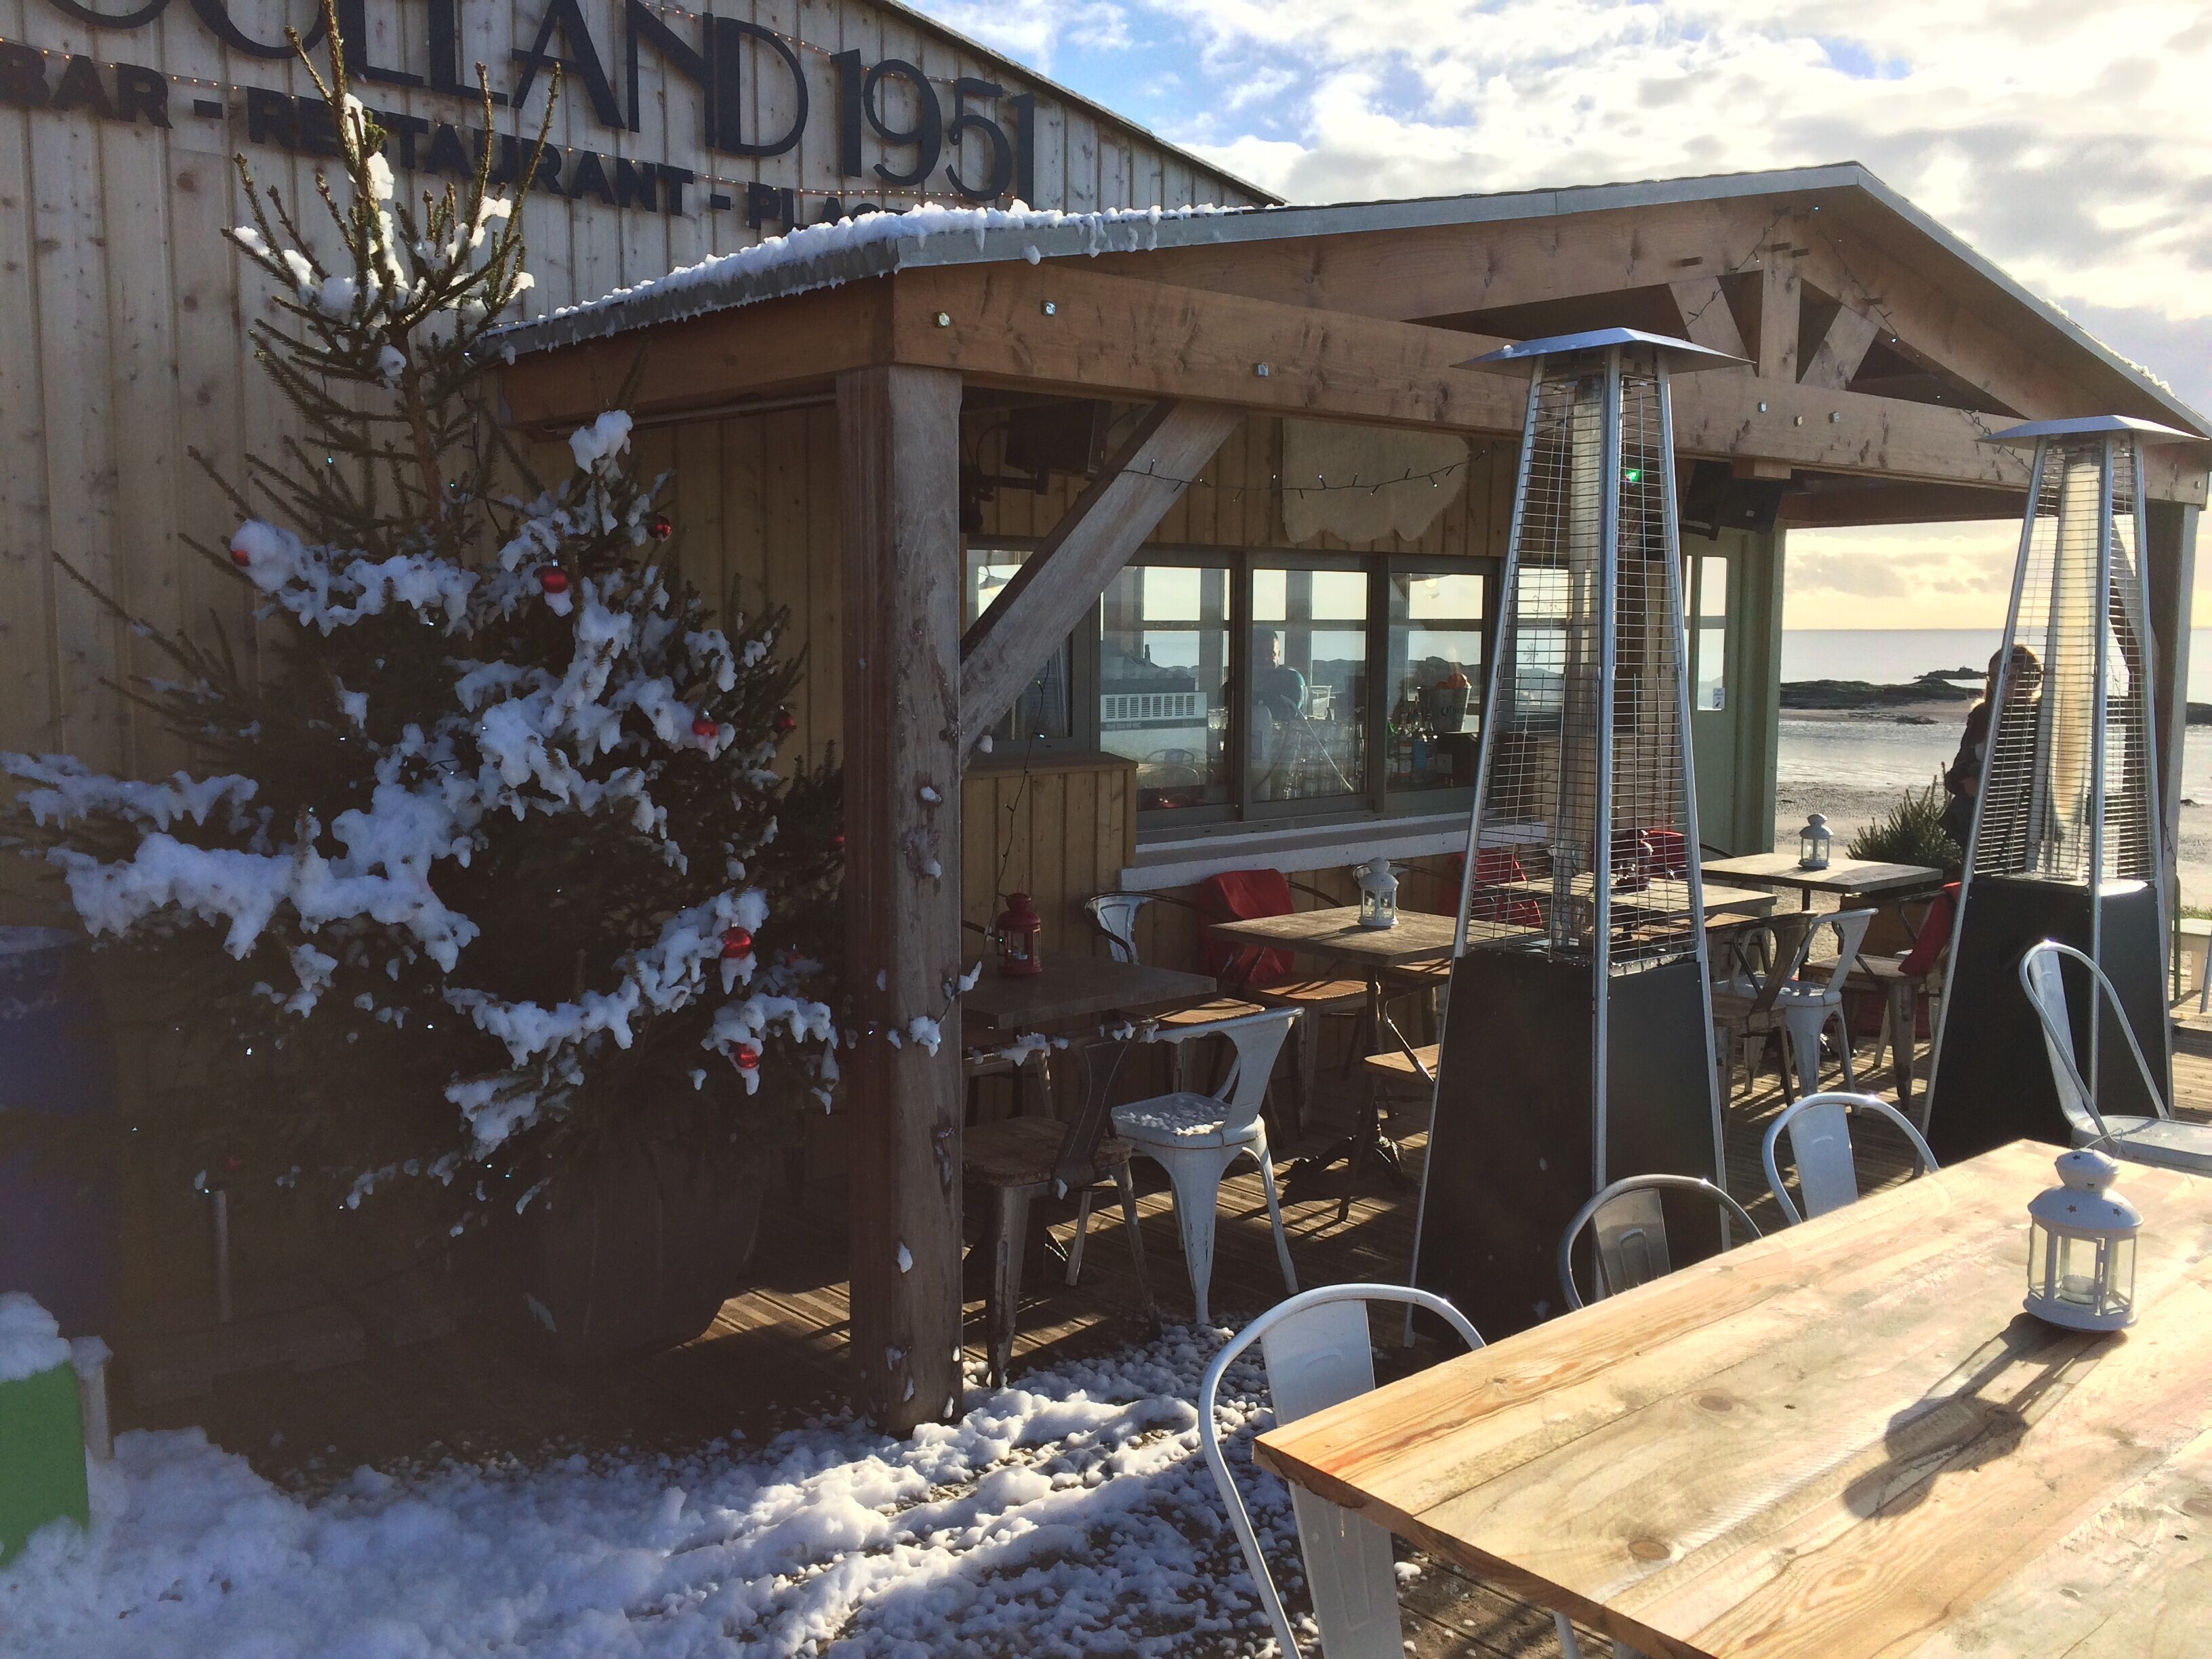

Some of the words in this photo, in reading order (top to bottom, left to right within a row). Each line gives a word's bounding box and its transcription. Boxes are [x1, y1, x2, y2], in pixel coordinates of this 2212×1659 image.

[0, 43, 173, 129] BAR
[247, 86, 694, 216] RETAURANT
[748, 182, 909, 234] PLA
[830, 49, 1035, 210] 1951
